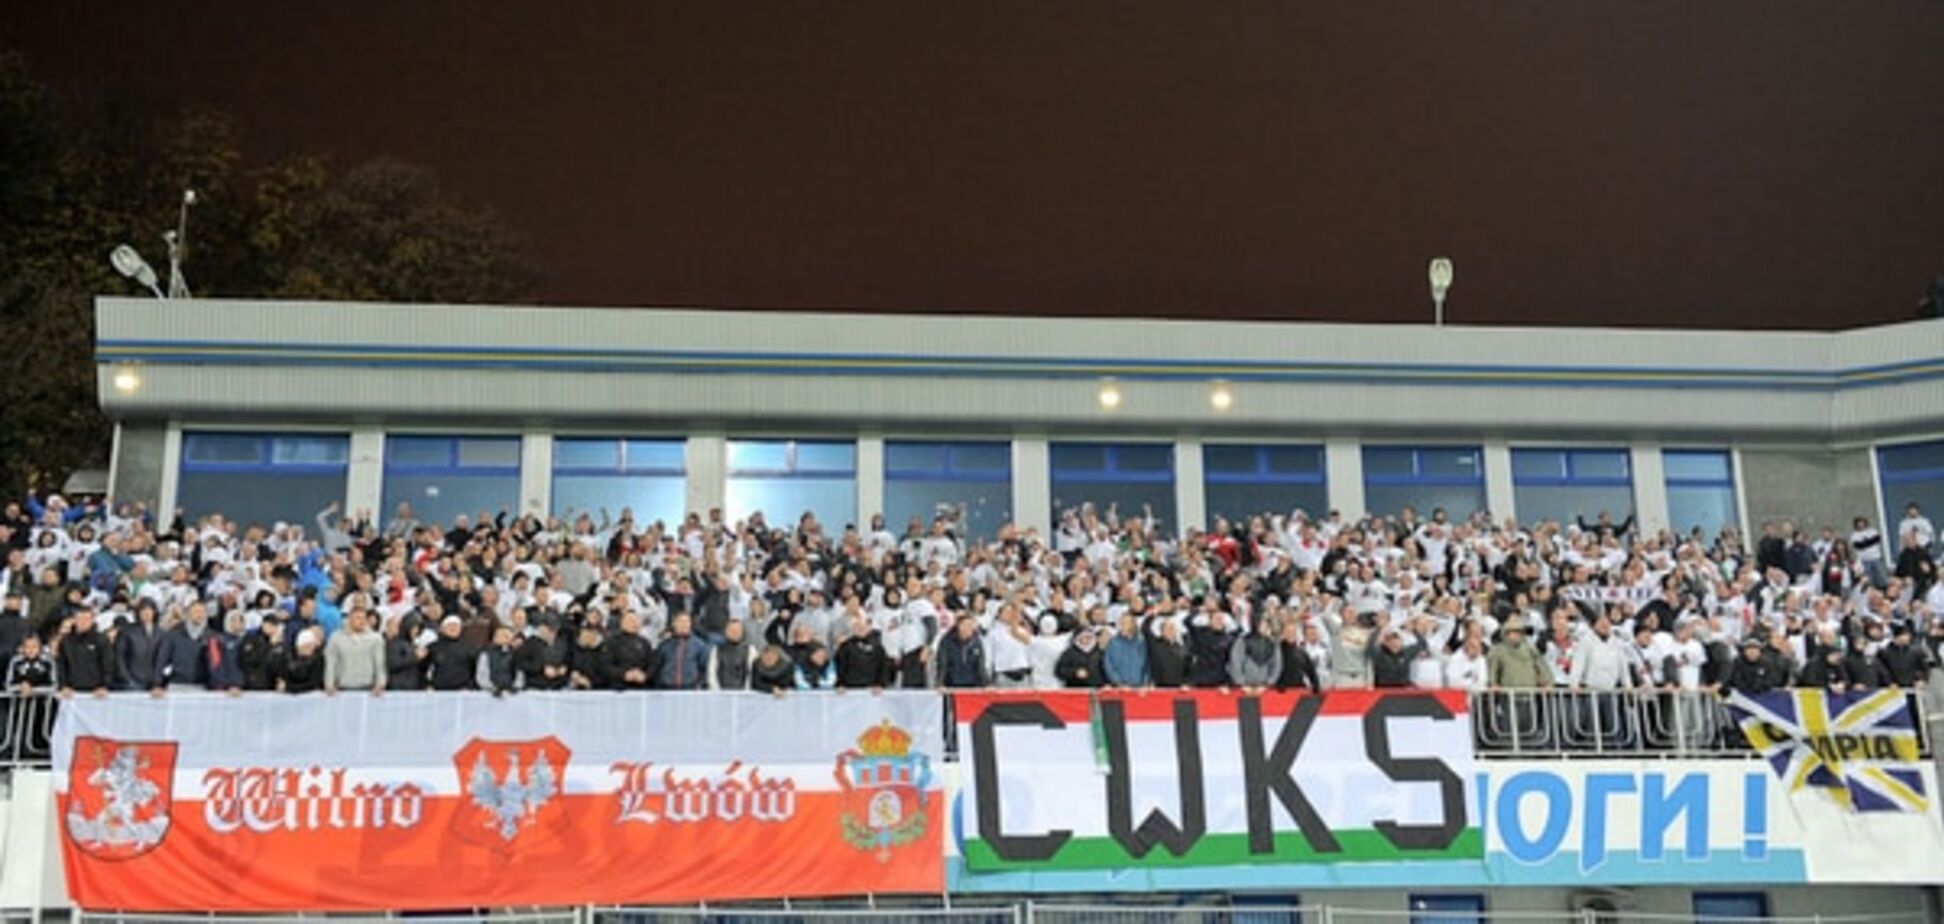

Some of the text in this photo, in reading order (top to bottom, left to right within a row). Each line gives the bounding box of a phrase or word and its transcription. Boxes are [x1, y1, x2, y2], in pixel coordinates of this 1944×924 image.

[202, 760, 797, 834] Wilno Lwów
[970, 695, 1468, 862] CWKS
